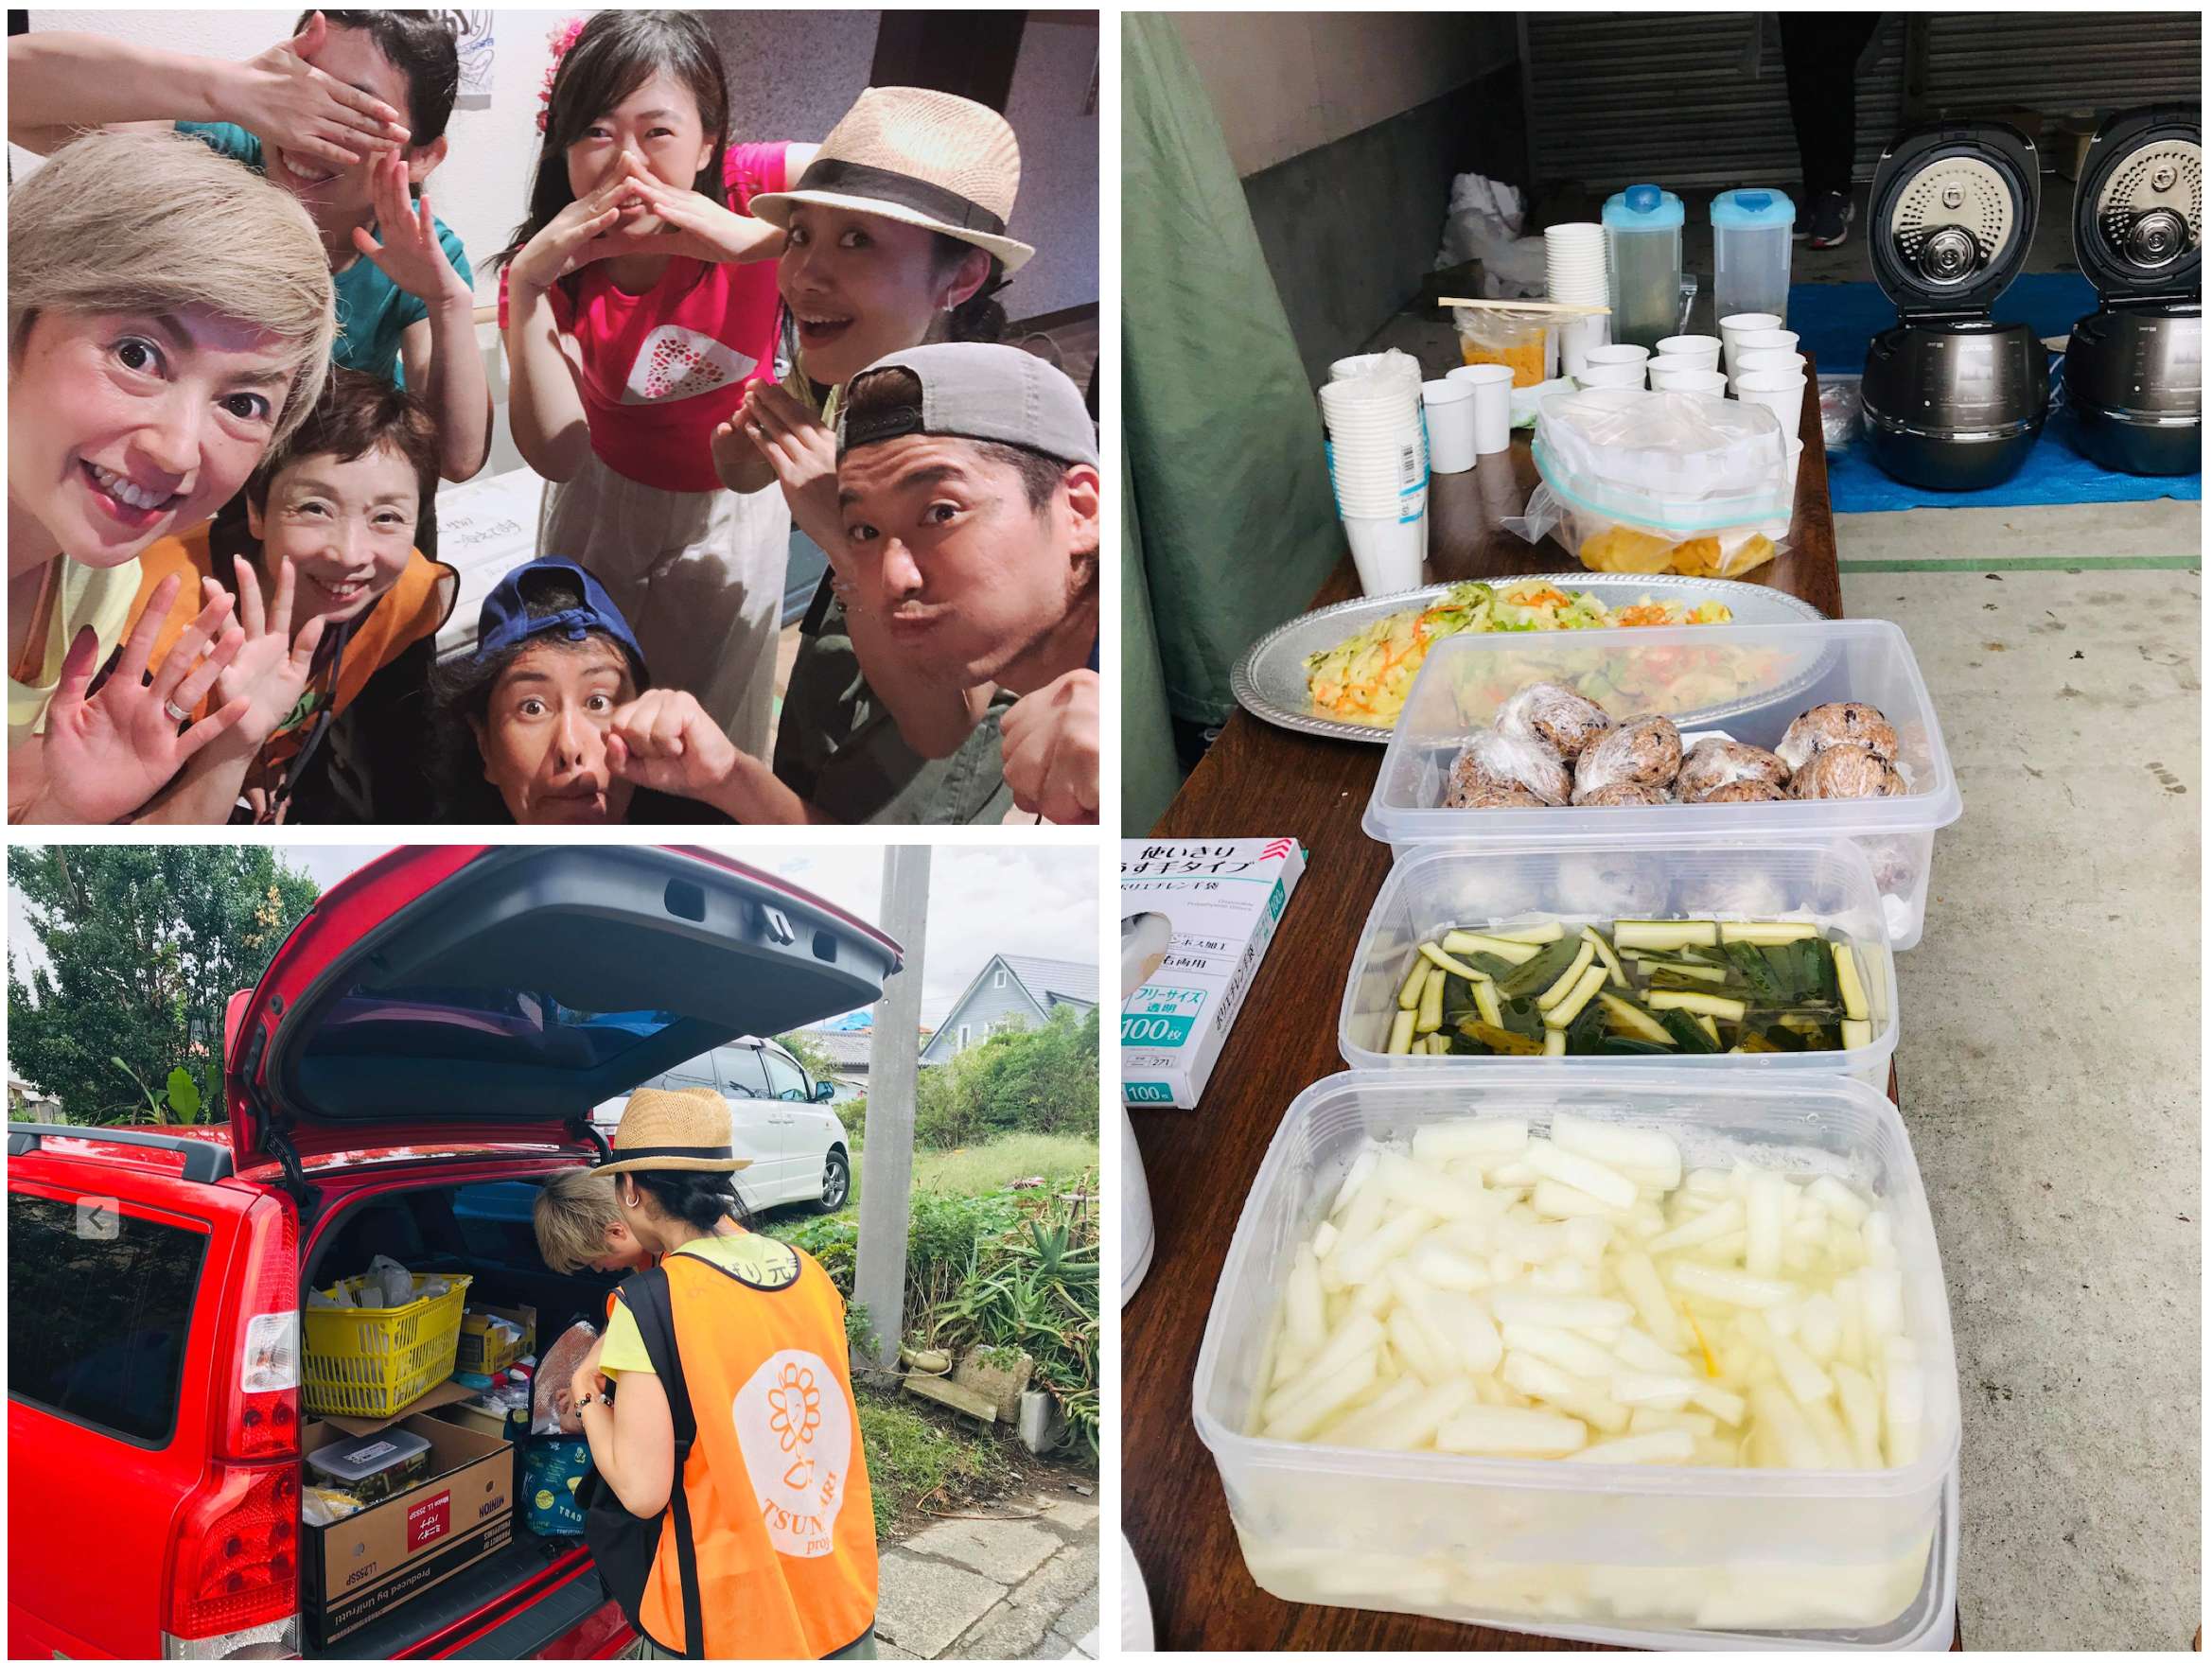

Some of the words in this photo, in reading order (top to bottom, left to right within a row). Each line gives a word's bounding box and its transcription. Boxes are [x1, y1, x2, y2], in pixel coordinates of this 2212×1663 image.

[1135, 988, 1203, 1003] フリーサイズ
[1146, 1003, 1178, 1013] 透明
[479, 1495, 505, 1519] MINION
[345, 1561, 378, 1586] LL25SSP
[391, 1567, 430, 1593] Produced
[377, 1586, 390, 1602] by
